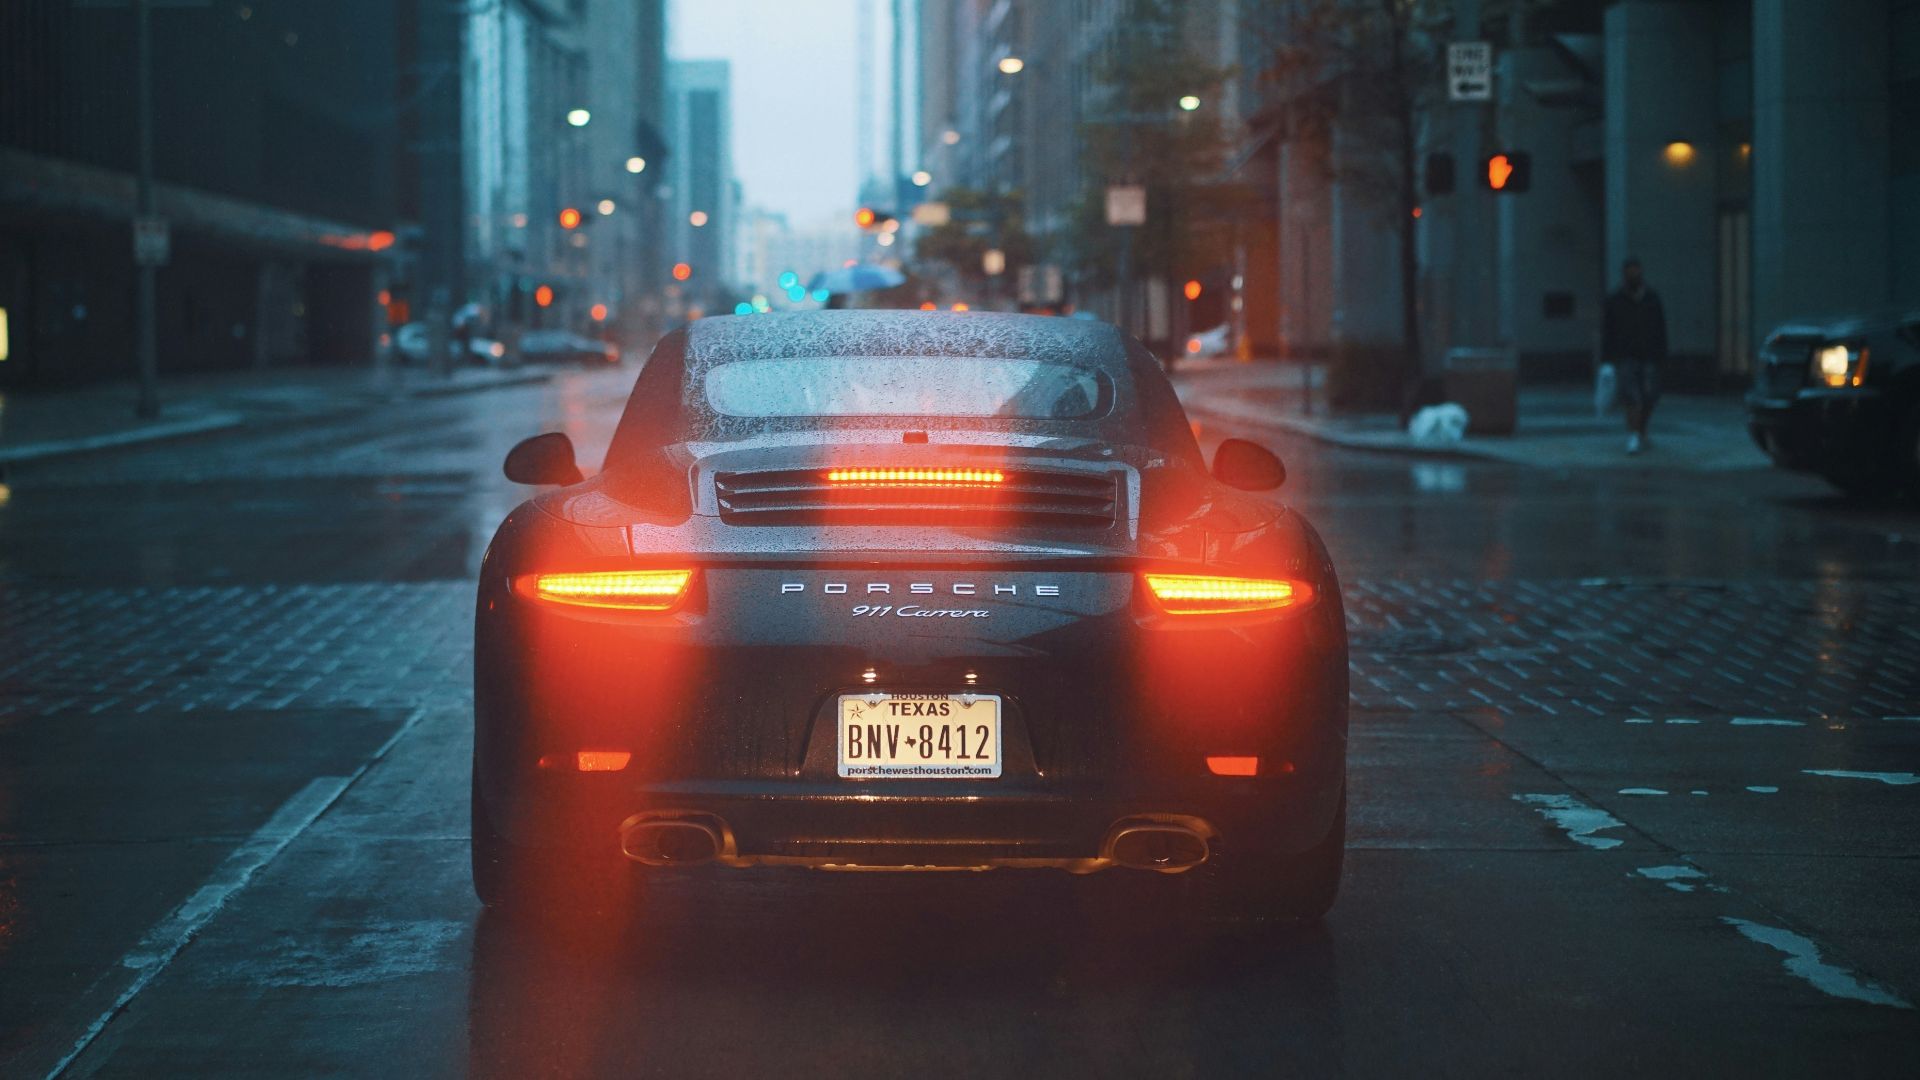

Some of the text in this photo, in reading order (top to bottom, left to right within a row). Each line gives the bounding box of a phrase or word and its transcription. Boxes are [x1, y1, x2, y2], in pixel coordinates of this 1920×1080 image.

[781, 583, 1060, 596] PORSCHE
[852, 605, 990, 618] 911 Carrera
[891, 693, 949, 701] HOUSTON
[888, 702, 950, 717] TEXAS
[848, 724, 990, 760] BNV 8412
[847, 765, 992, 776] porschewesthouston.com
